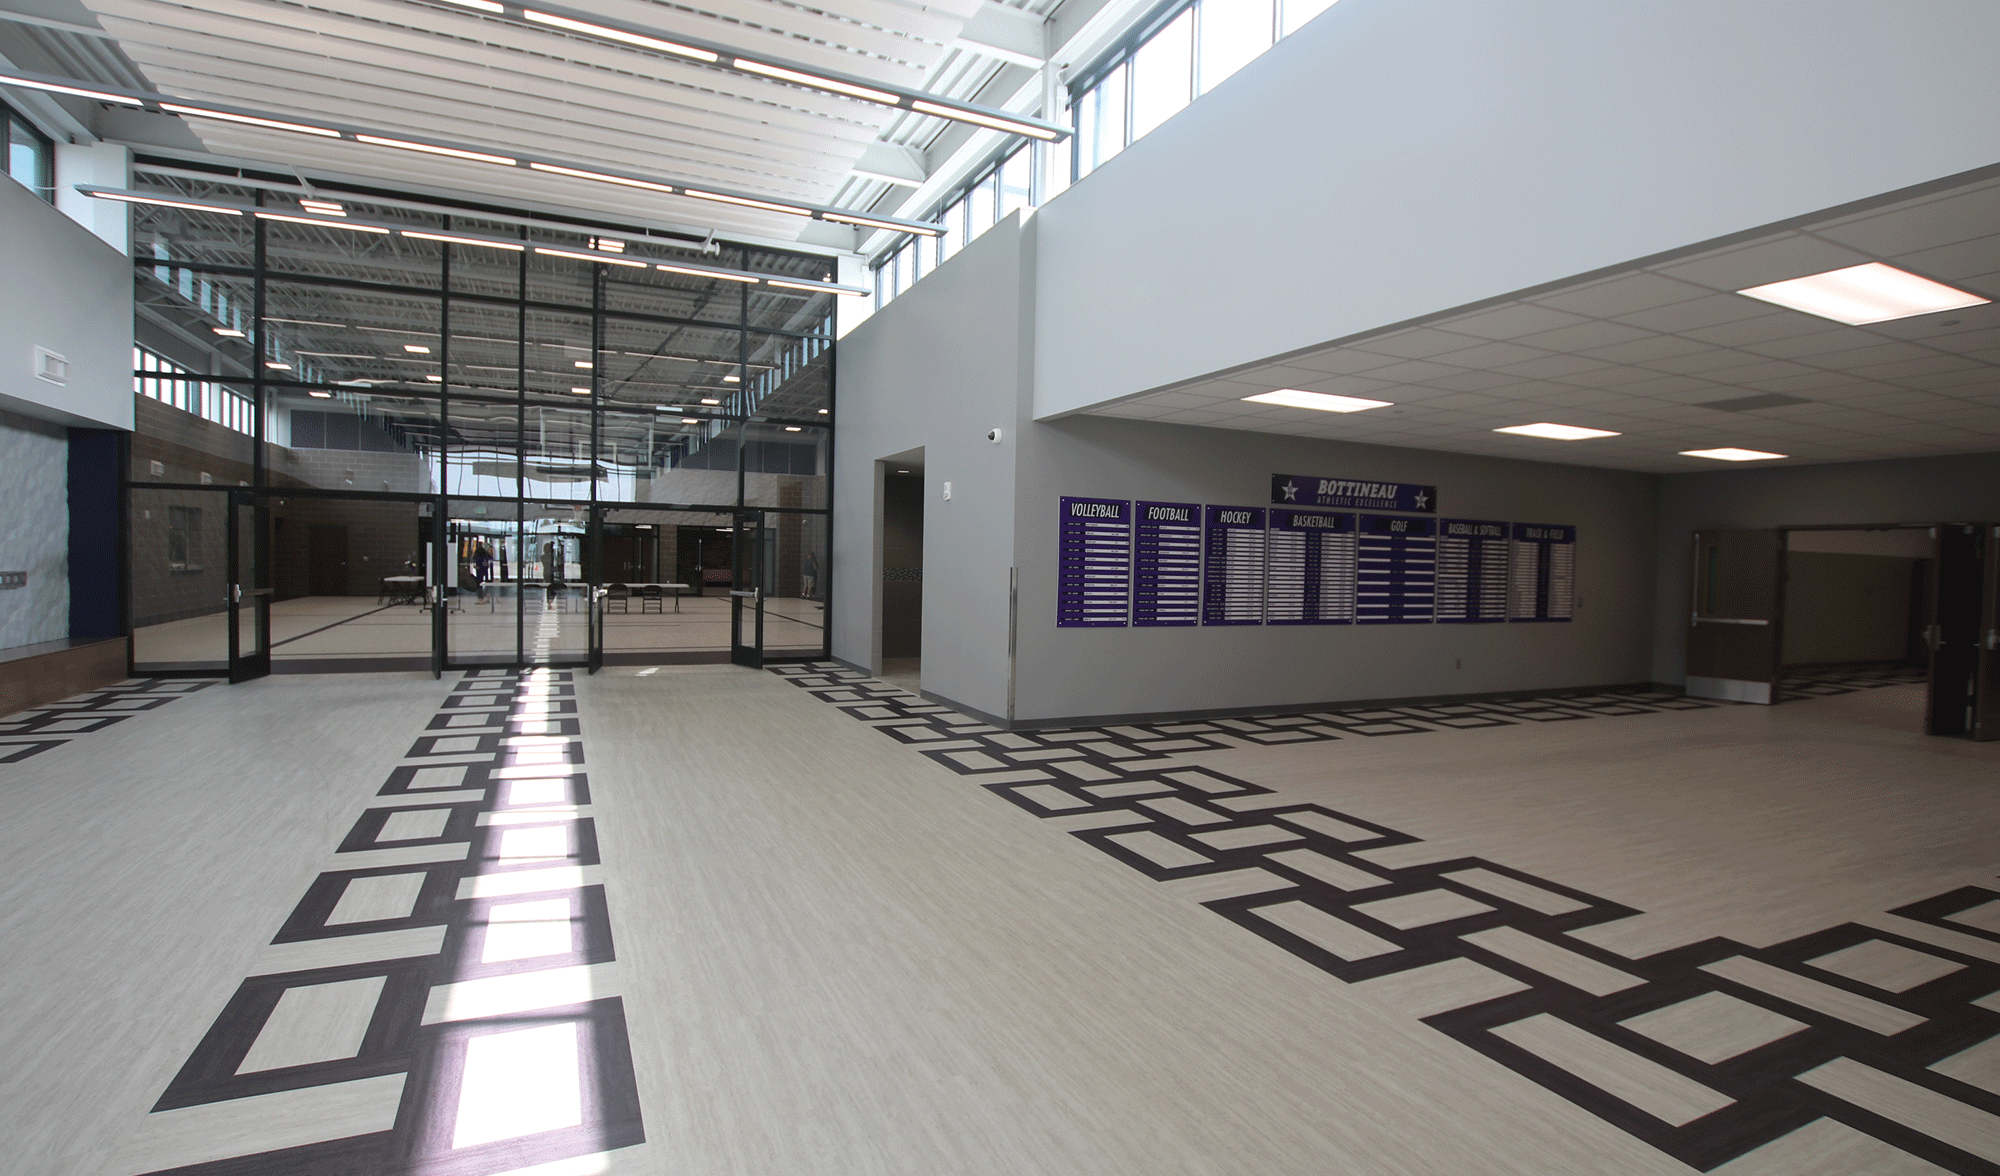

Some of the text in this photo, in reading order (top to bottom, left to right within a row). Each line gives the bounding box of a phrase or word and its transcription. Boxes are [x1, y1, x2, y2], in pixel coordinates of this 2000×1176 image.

[1317, 479, 1398, 499] BOTTINEAU
[1317, 496, 1398, 509] ATHLETIC EXCELLENCE
[1071, 503, 1119, 518] VOLLEYBALL
[1148, 507, 1189, 521] FOOTBALL
[1220, 511, 1251, 524] HOCKEY
[1293, 515, 1335, 529] BASKETBALL
[1391, 520, 1408, 532] GOLF
[1448, 523, 1473, 535] BASEBALL
[1526, 527, 1542, 539] TRACK
[1549, 529, 1564, 540] FIELD
